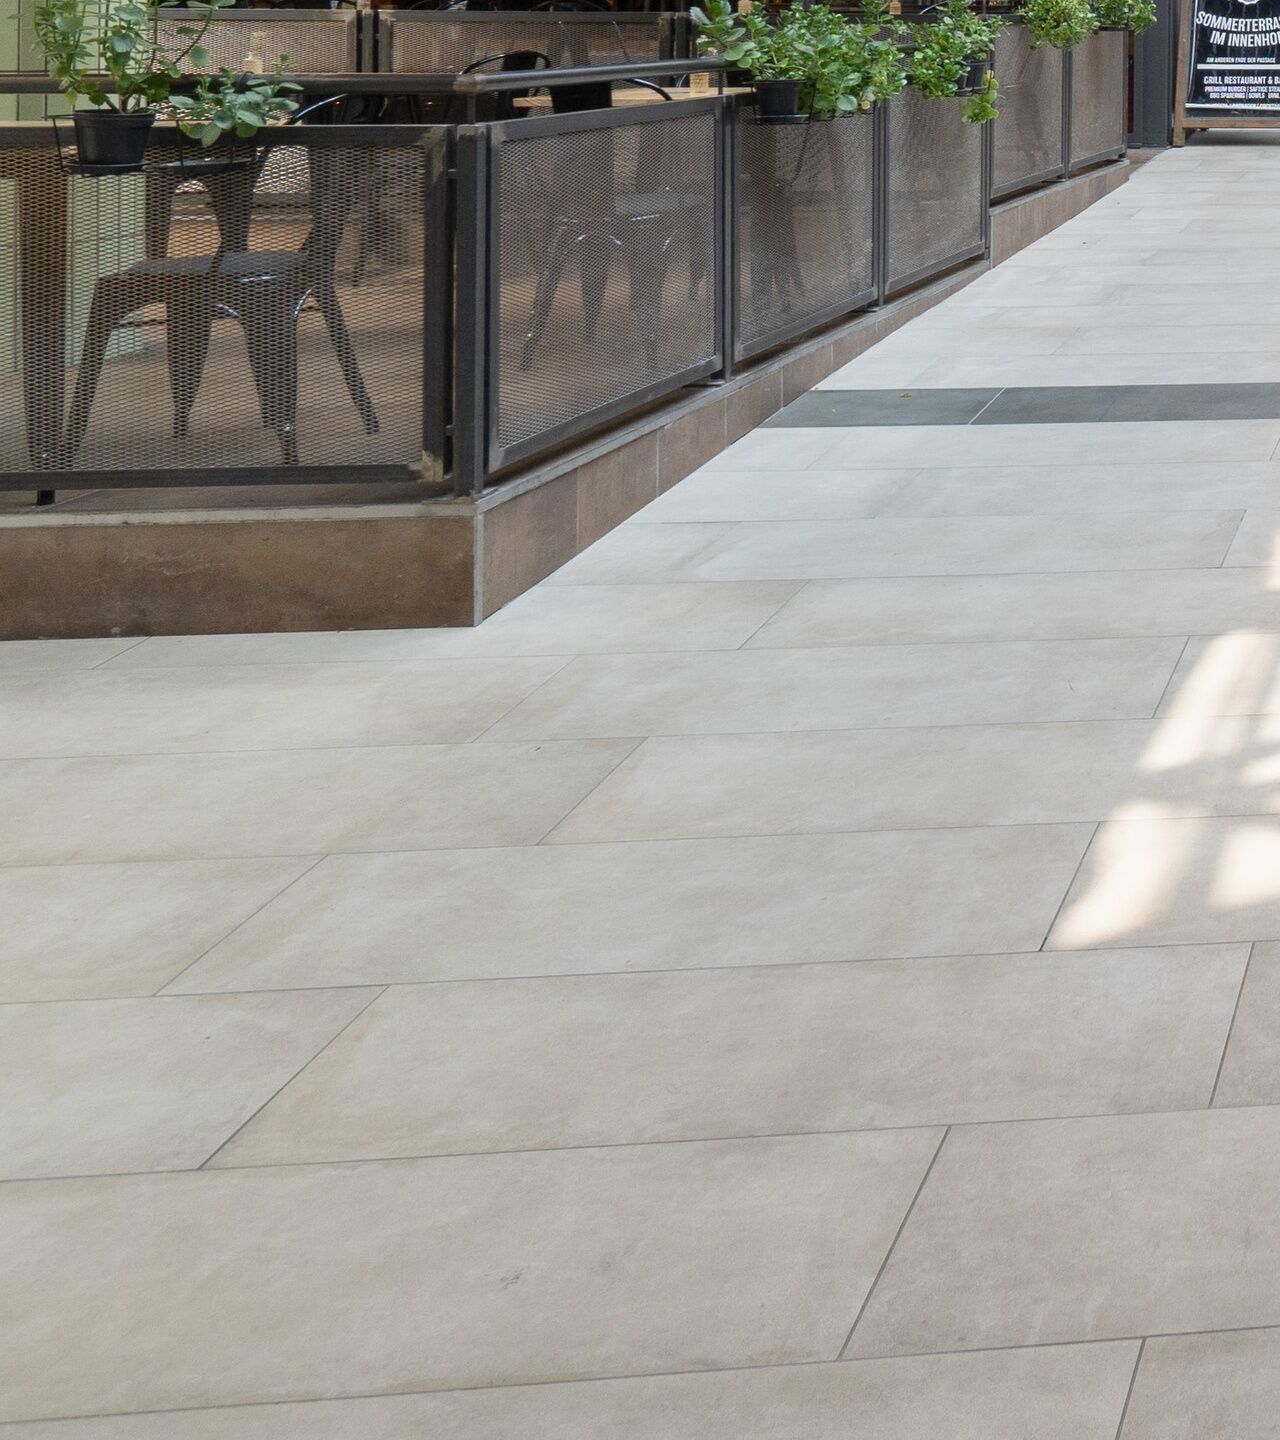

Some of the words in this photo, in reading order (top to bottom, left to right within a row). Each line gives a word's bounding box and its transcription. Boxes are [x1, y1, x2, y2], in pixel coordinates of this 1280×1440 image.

[1210, 30, 1226, 45] IM
[1203, 76, 1222, 84] GRILL
[1224, 76, 1266, 84] RESTAURANT
